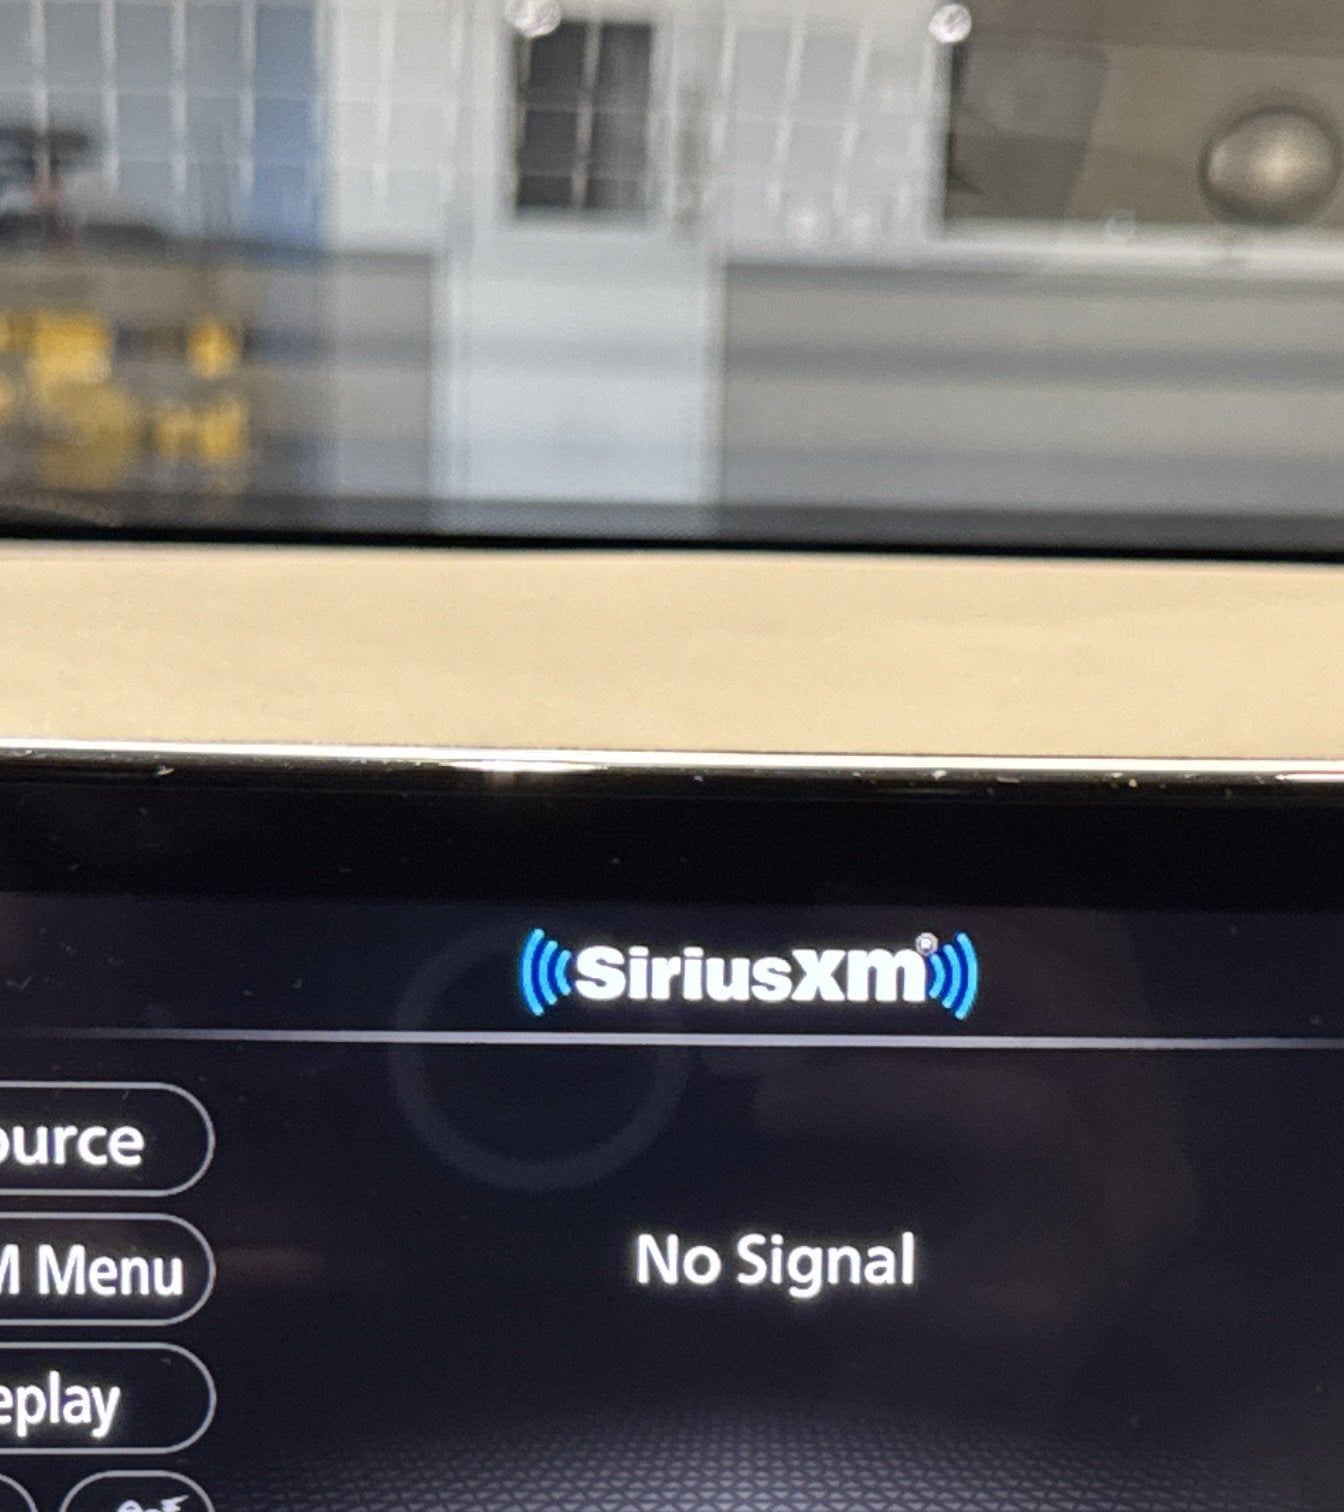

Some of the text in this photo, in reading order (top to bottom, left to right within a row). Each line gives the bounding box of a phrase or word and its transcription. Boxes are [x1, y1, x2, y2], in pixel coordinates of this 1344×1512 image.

[37, 1244, 183, 1297] Menu
[636, 1231, 915, 1299] No Signal
